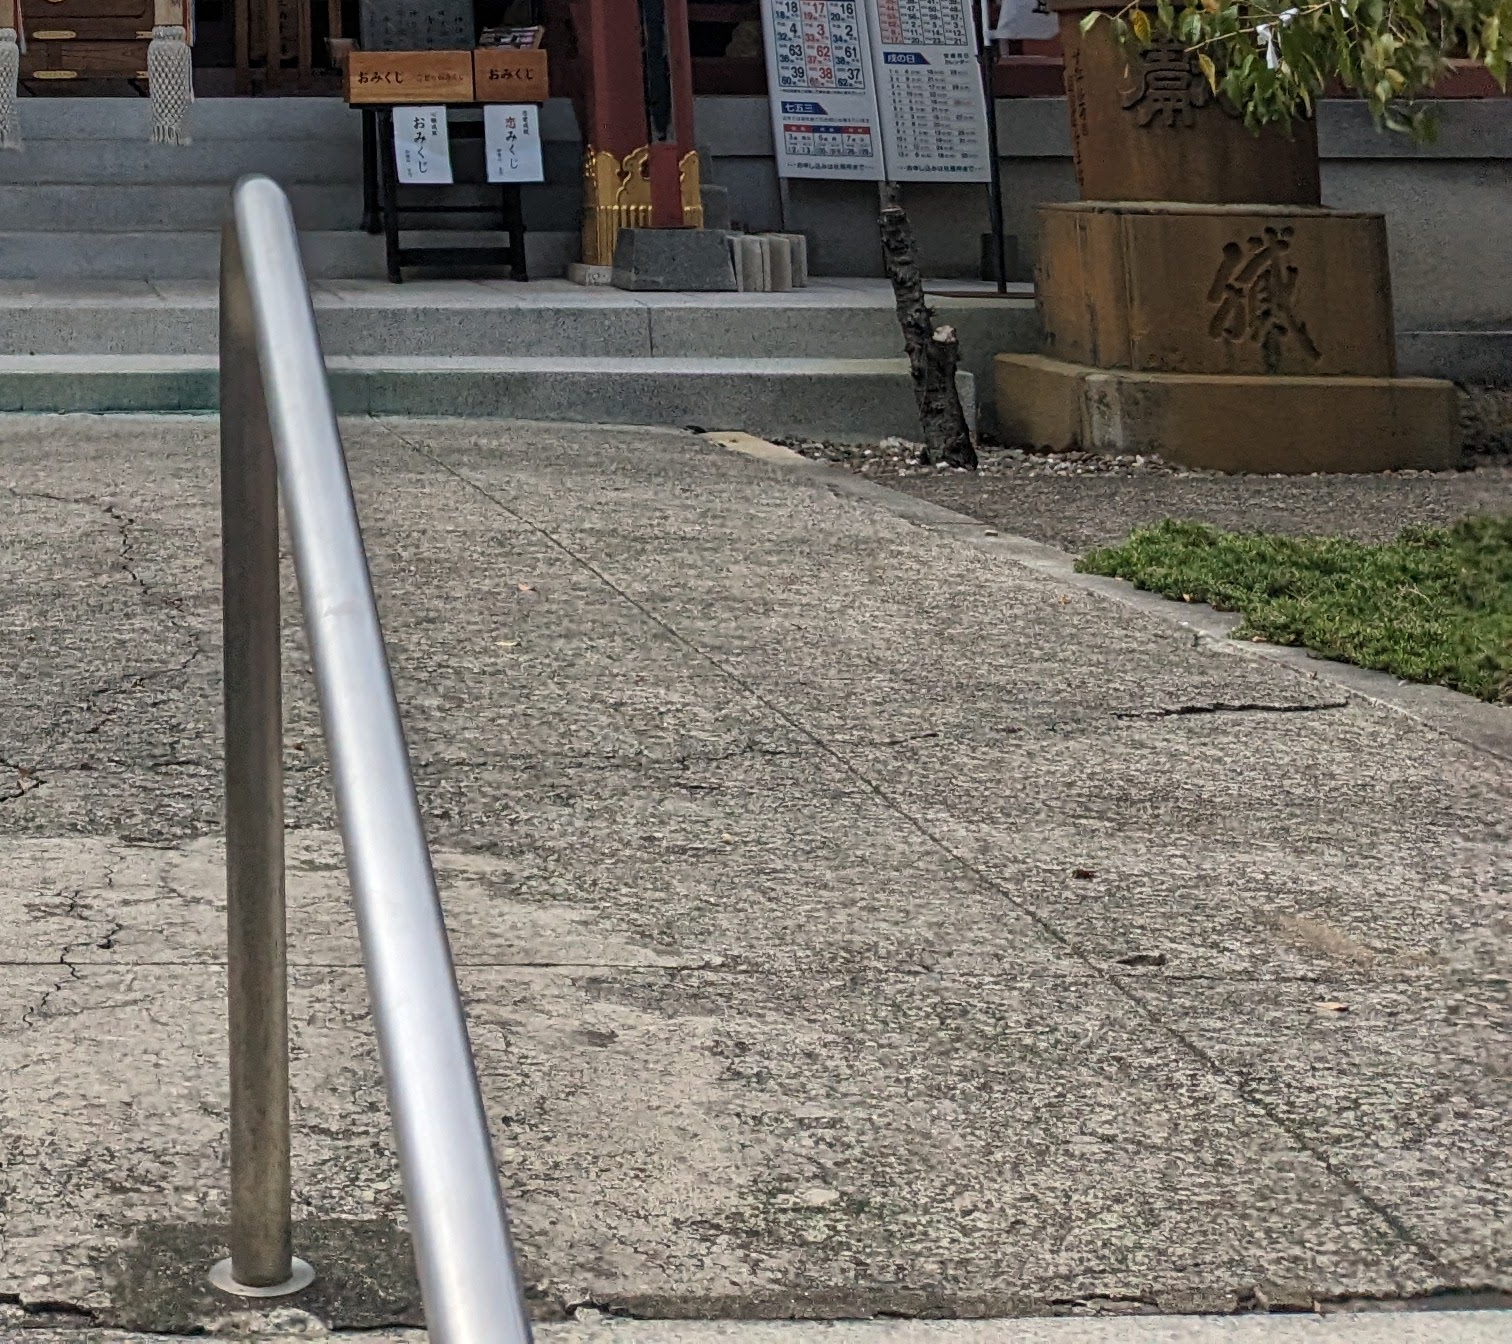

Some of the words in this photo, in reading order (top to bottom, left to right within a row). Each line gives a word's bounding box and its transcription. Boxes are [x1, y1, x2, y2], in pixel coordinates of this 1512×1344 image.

[357, 71, 405, 84] おみくじ
[488, 68, 534, 81] おみくじ
[785, 104, 813, 112] 七五三
[413, 116, 428, 174] おみくじ
[505, 116, 519, 170] 恋みくじ
